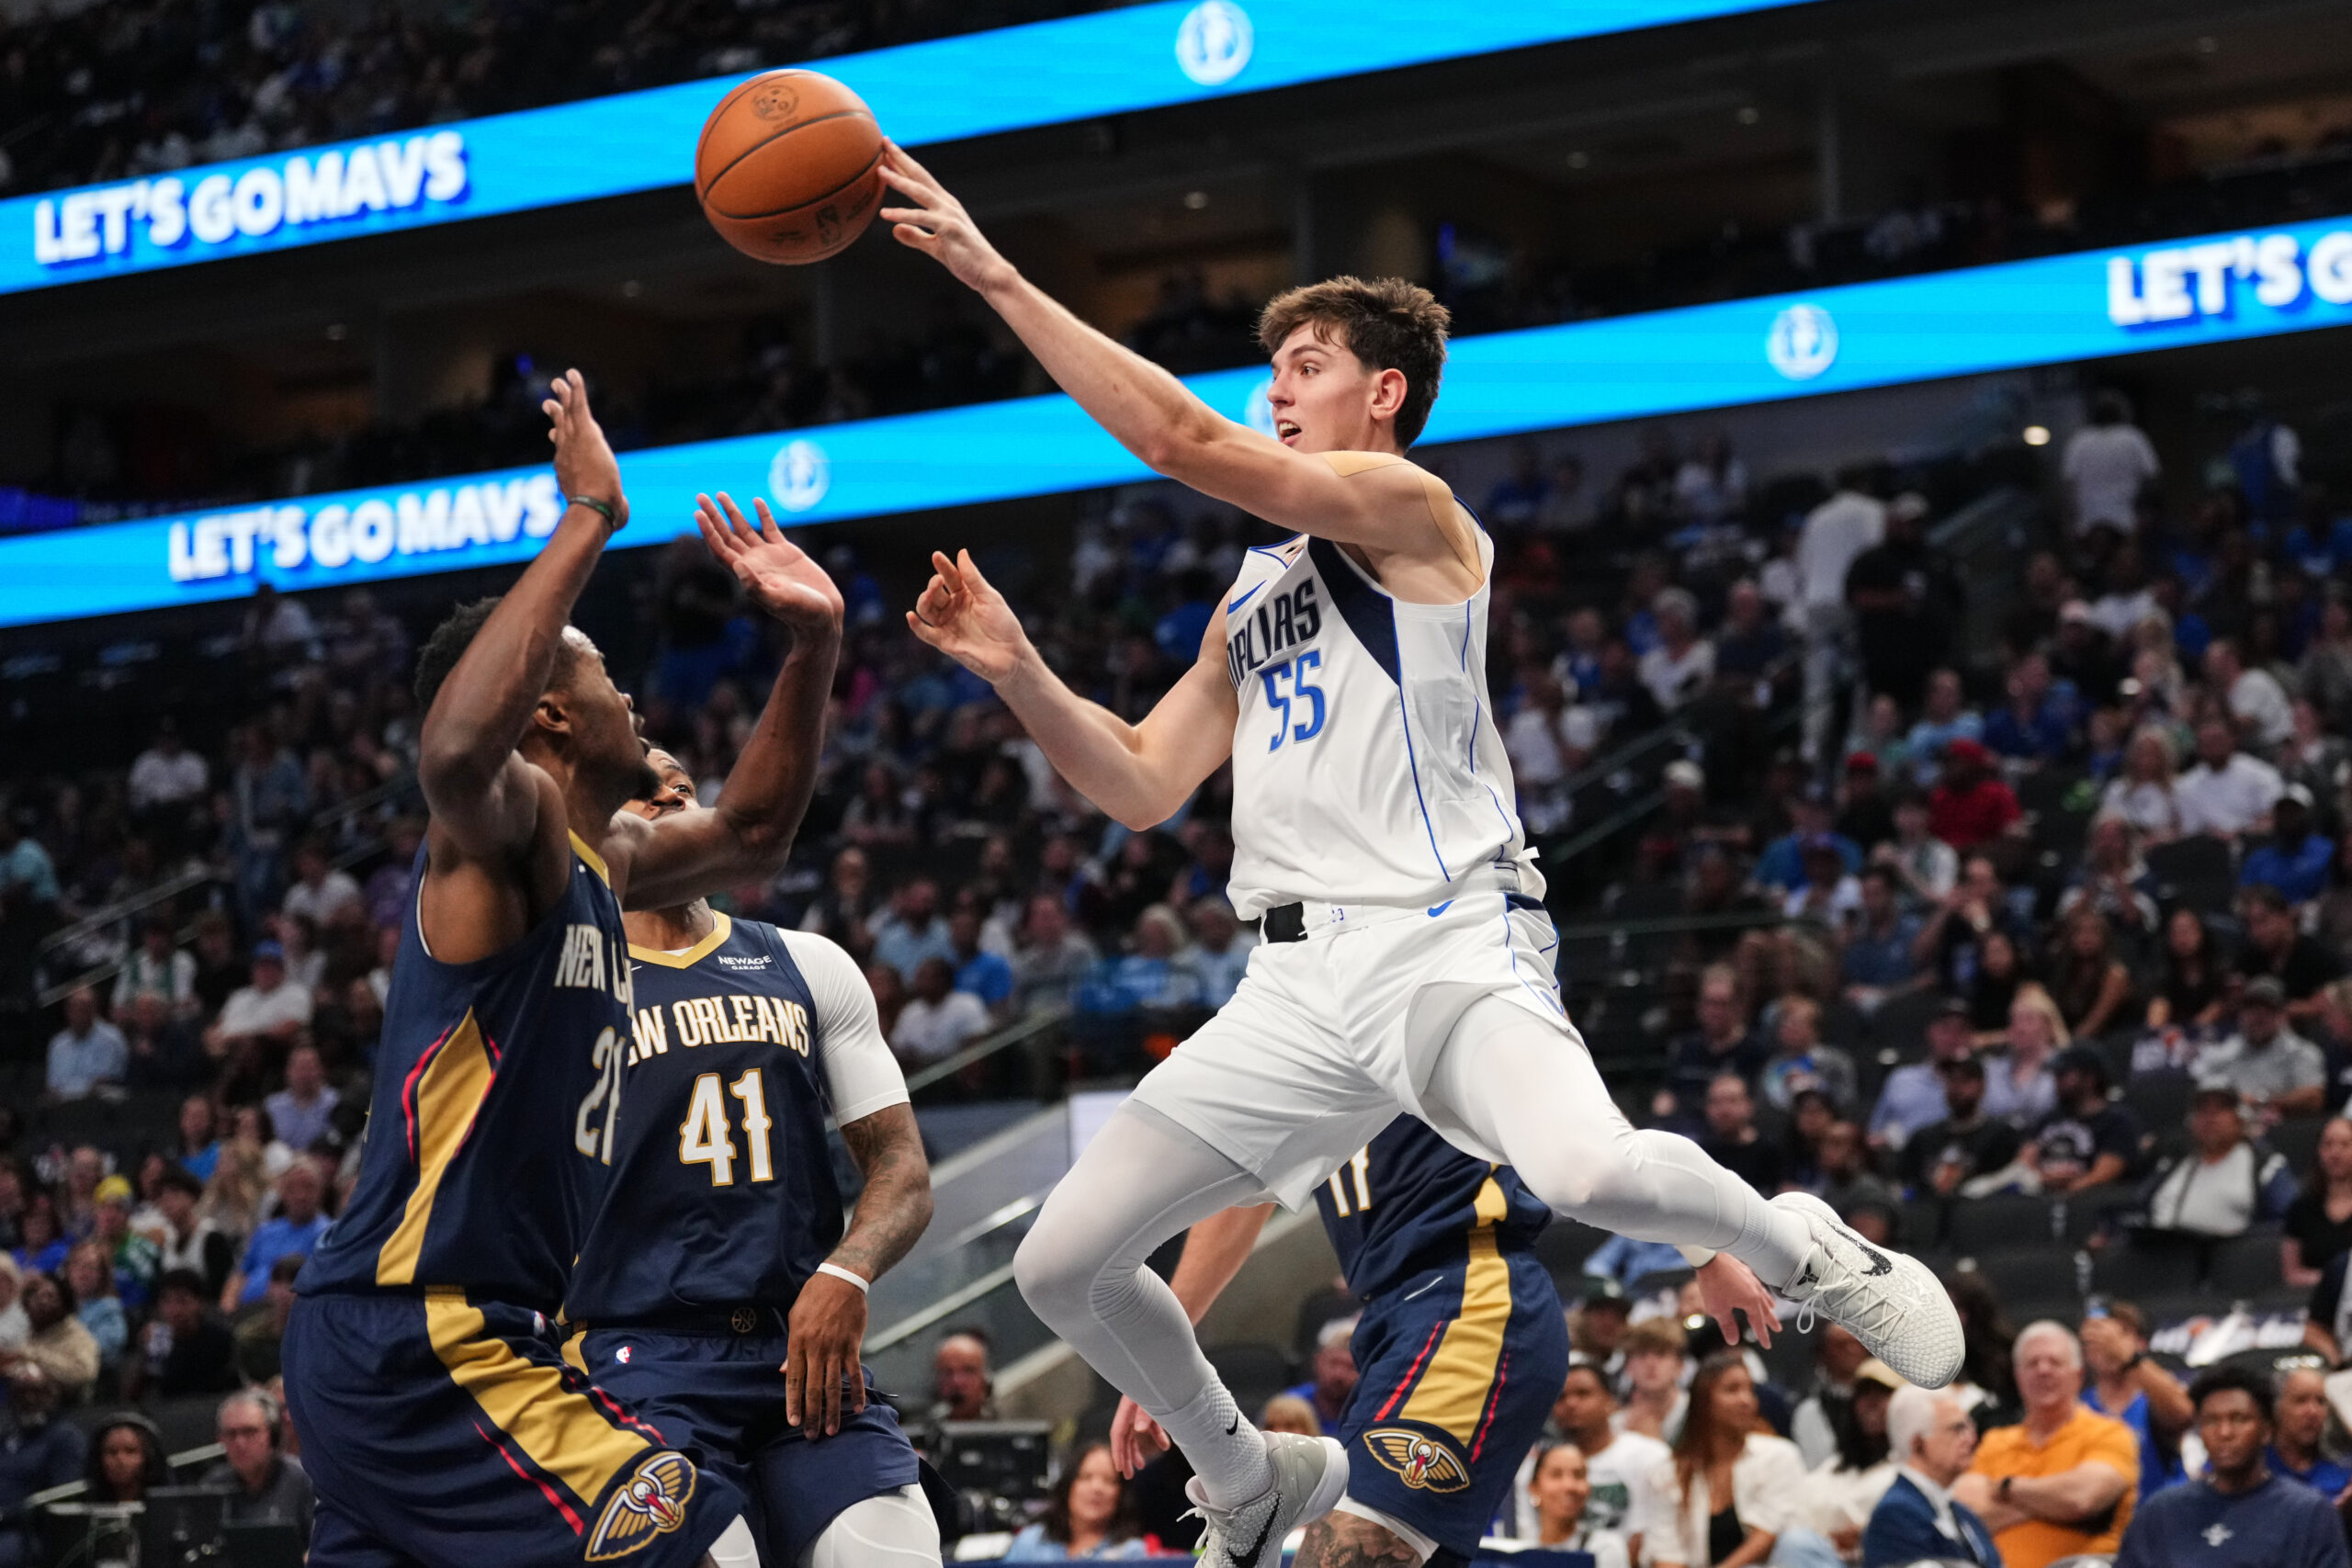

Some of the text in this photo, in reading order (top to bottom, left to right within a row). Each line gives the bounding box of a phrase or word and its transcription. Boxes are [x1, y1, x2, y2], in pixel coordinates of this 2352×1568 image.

[34, 131, 465, 264] LET'S GO MAVS
[2108, 232, 2301, 325] LET'S
[169, 474, 560, 581] LET'S GO MAVS
[1257, 647, 1327, 754] 55
[672, 996, 809, 1057] ORLEANS
[575, 1026, 627, 1167] 21
[678, 1067, 774, 1187] 41
